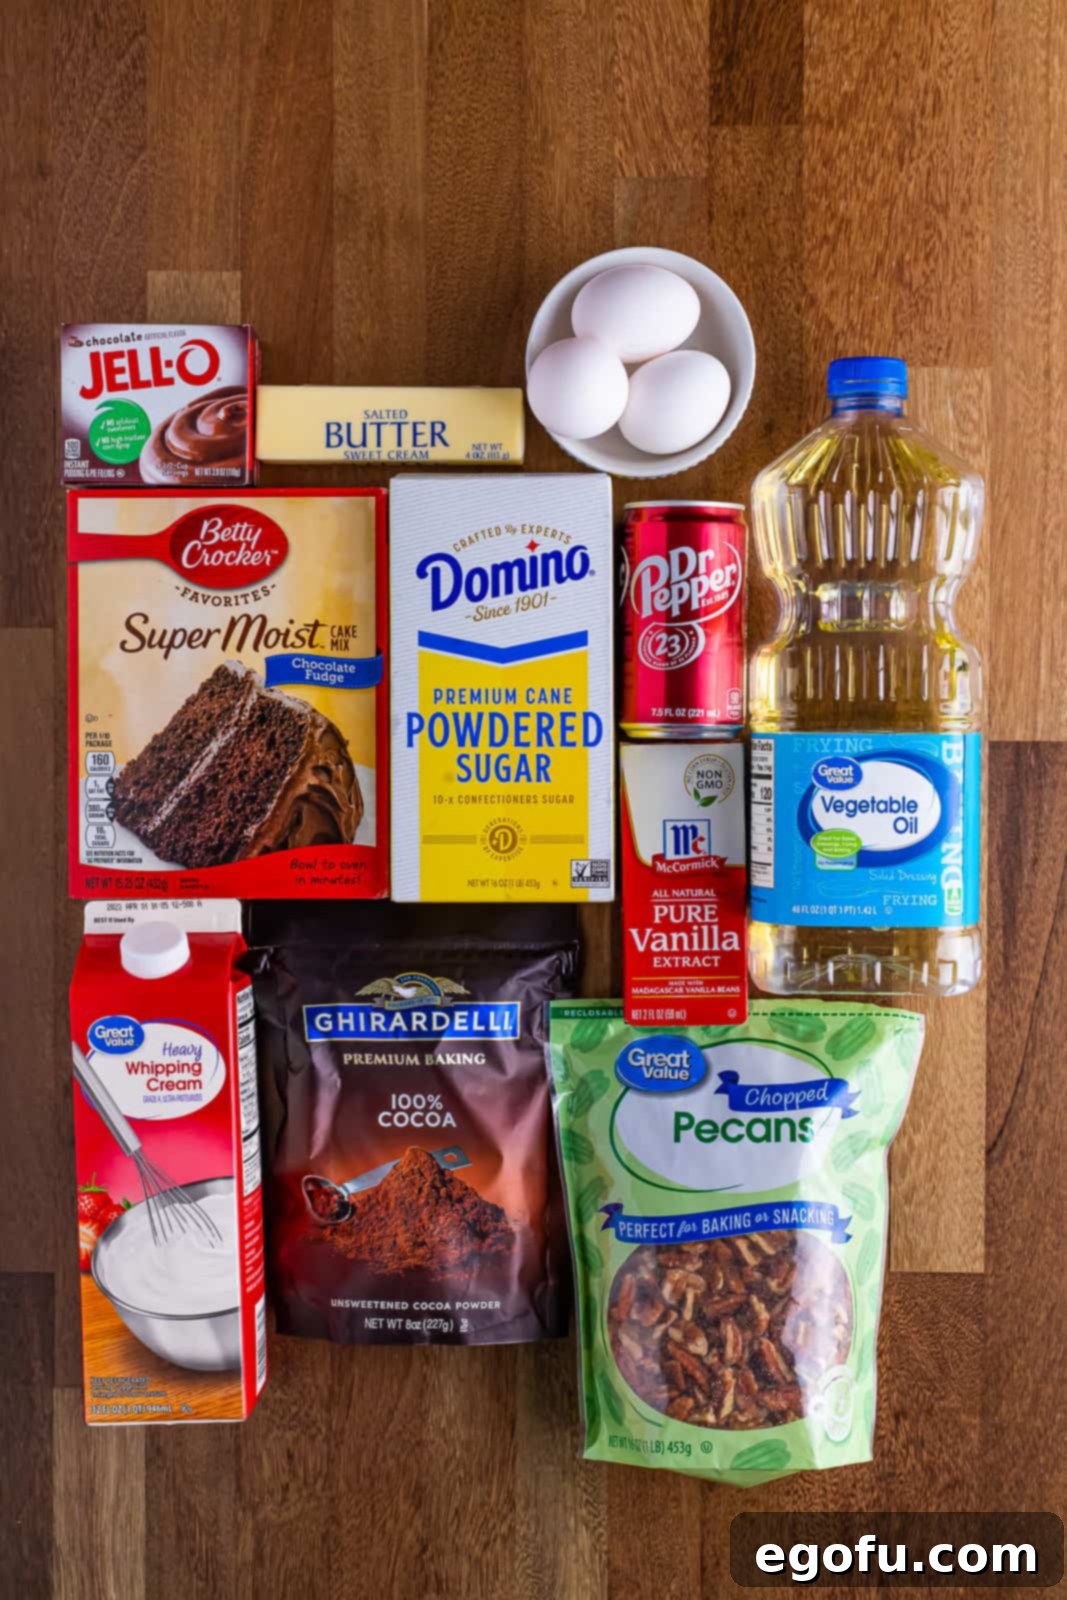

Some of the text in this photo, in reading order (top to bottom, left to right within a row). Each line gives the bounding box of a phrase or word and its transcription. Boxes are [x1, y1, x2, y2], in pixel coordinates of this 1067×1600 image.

[86, 332, 143, 347] chocolate
[363, 409, 408, 420] SALTED
[324, 421, 450, 449] BUTTER
[471, 443, 503, 451] NET WT
[343, 450, 429, 460] SWEET CREAM
[199, 517, 262, 549] Betty
[453, 526, 502, 553] CRAFTED
[521, 524, 572, 545] EXPERTS
[181, 540, 272, 569] Crocker
[669, 546, 715, 585] Dr
[416, 545, 590, 612] Domino
[631, 555, 737, 619] Pepper
[330, 625, 357, 638] CAKE
[330, 638, 350, 651] MIX
[655, 633, 681, 658] 23
[291, 657, 356, 674] Chocolate
[304, 669, 345, 684] Fudge
[433, 688, 573, 704] PREMIUM CANE
[675, 708, 686, 717] OZ
[406, 711, 603, 748] POWDERED
[792, 738, 873, 753] FRYING
[92, 754, 110, 765] 160
[457, 753, 552, 783] SUGAR
[696, 770, 723, 780] NON
[818, 764, 854, 777] Great
[696, 780, 724, 790] GMO
[827, 775, 854, 785] Value
[458, 795, 538, 805] CONFECTIONERS
[542, 795, 575, 805] SUGAR
[821, 795, 919, 818] Vegetable
[893, 817, 919, 835] Oil
[290, 858, 368, 870] Bowl to oven
[655, 859, 719, 874] McCormick
[85, 878, 98, 889] NET
[311, 874, 361, 885] minutes!
[897, 869, 938, 886] Dressing
[652, 889, 717, 898] ALL NATURAL
[881, 894, 938, 907] FRYING
[653, 904, 718, 923] PURE
[629, 926, 741, 953] Vanilla
[653, 956, 721, 968] EXTRACT
[632, 985, 740, 995] MADAGASCAR VANILLA BEANS
[314, 1011, 514, 1032] GHIRARDELLI
[95, 1025, 135, 1039] Great
[105, 1036, 135, 1048] Value
[162, 1042, 202, 1062] Heavy
[343, 1053, 487, 1066] PREMIUM BAKING
[627, 1048, 691, 1068] Great
[125, 1060, 202, 1077] Whipping
[642, 1066, 691, 1082] Value
[146, 1078, 203, 1092] Cream
[391, 1094, 444, 1110] 100%
[745, 1086, 829, 1112] Chopped
[377, 1112, 457, 1128] COCOA
[673, 1112, 815, 1144] Pecans
[618, 1208, 836, 1239] PERFECT for BAKING or SNACKING
[331, 1298, 502, 1311] UNSWEETENED COCOA POWDER
[364, 1318, 384, 1330] NET
[387, 1318, 404, 1330] WT
[667, 1440, 692, 1457] 453g
